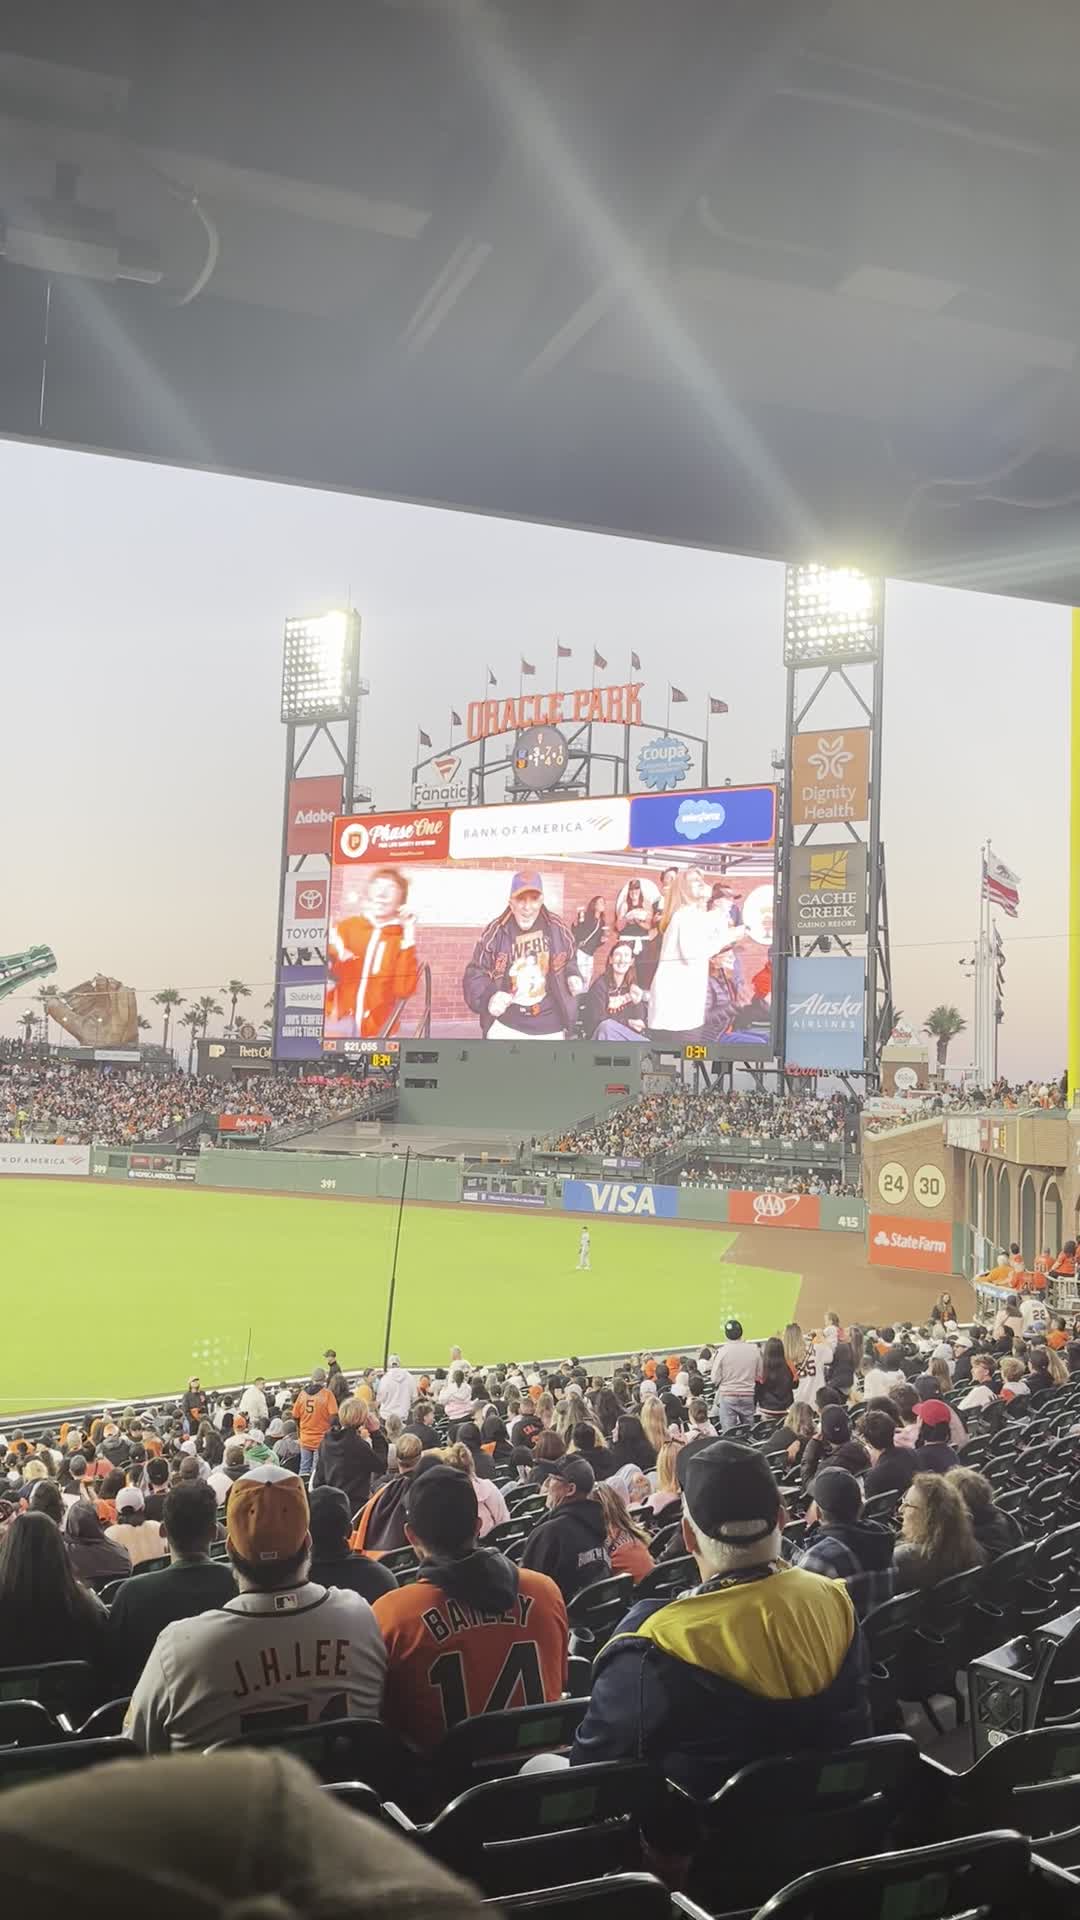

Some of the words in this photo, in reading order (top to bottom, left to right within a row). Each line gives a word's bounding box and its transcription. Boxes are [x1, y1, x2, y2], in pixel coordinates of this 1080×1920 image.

[466, 691, 565, 742] ORACLE
[573, 681, 647, 725] PARK
[643, 745, 686, 761] coupa
[802, 787, 857, 805] Dignity
[294, 808, 335, 824] Adobe
[804, 803, 854, 819] Health
[368, 823, 414, 845] Phase
[413, 817, 444, 837] One
[463, 827, 497, 839] BANK
[502, 826, 517, 837] OF
[521, 822, 583, 835] AMERICA
[797, 892, 857, 906] CACHE
[799, 905, 856, 919] CREEK
[797, 920, 826, 929] CASINO
[829, 919, 857, 929] RESORT
[788, 992, 863, 1018] Alaska
[792, 1019, 855, 1030] AIRLINES
[372, 1054, 391, 1066] 0:34
[686, 1045, 707, 1059] 0:34
[10, 1156, 21, 1164] OF
[23, 1157, 65, 1165] AMERICA
[320, 1179, 336, 1189] 391
[884, 1174, 905, 1192] 24
[919, 1176, 940, 1196] 30
[585, 1182, 656, 1215] VISA
[756, 1196, 784, 1213] AAA
[838, 1216, 859, 1228] 415
[305, 1399, 314, 1414] 5
[233, 1639, 350, 1697] J.H.LEE
[427, 1639, 546, 1728] 14
